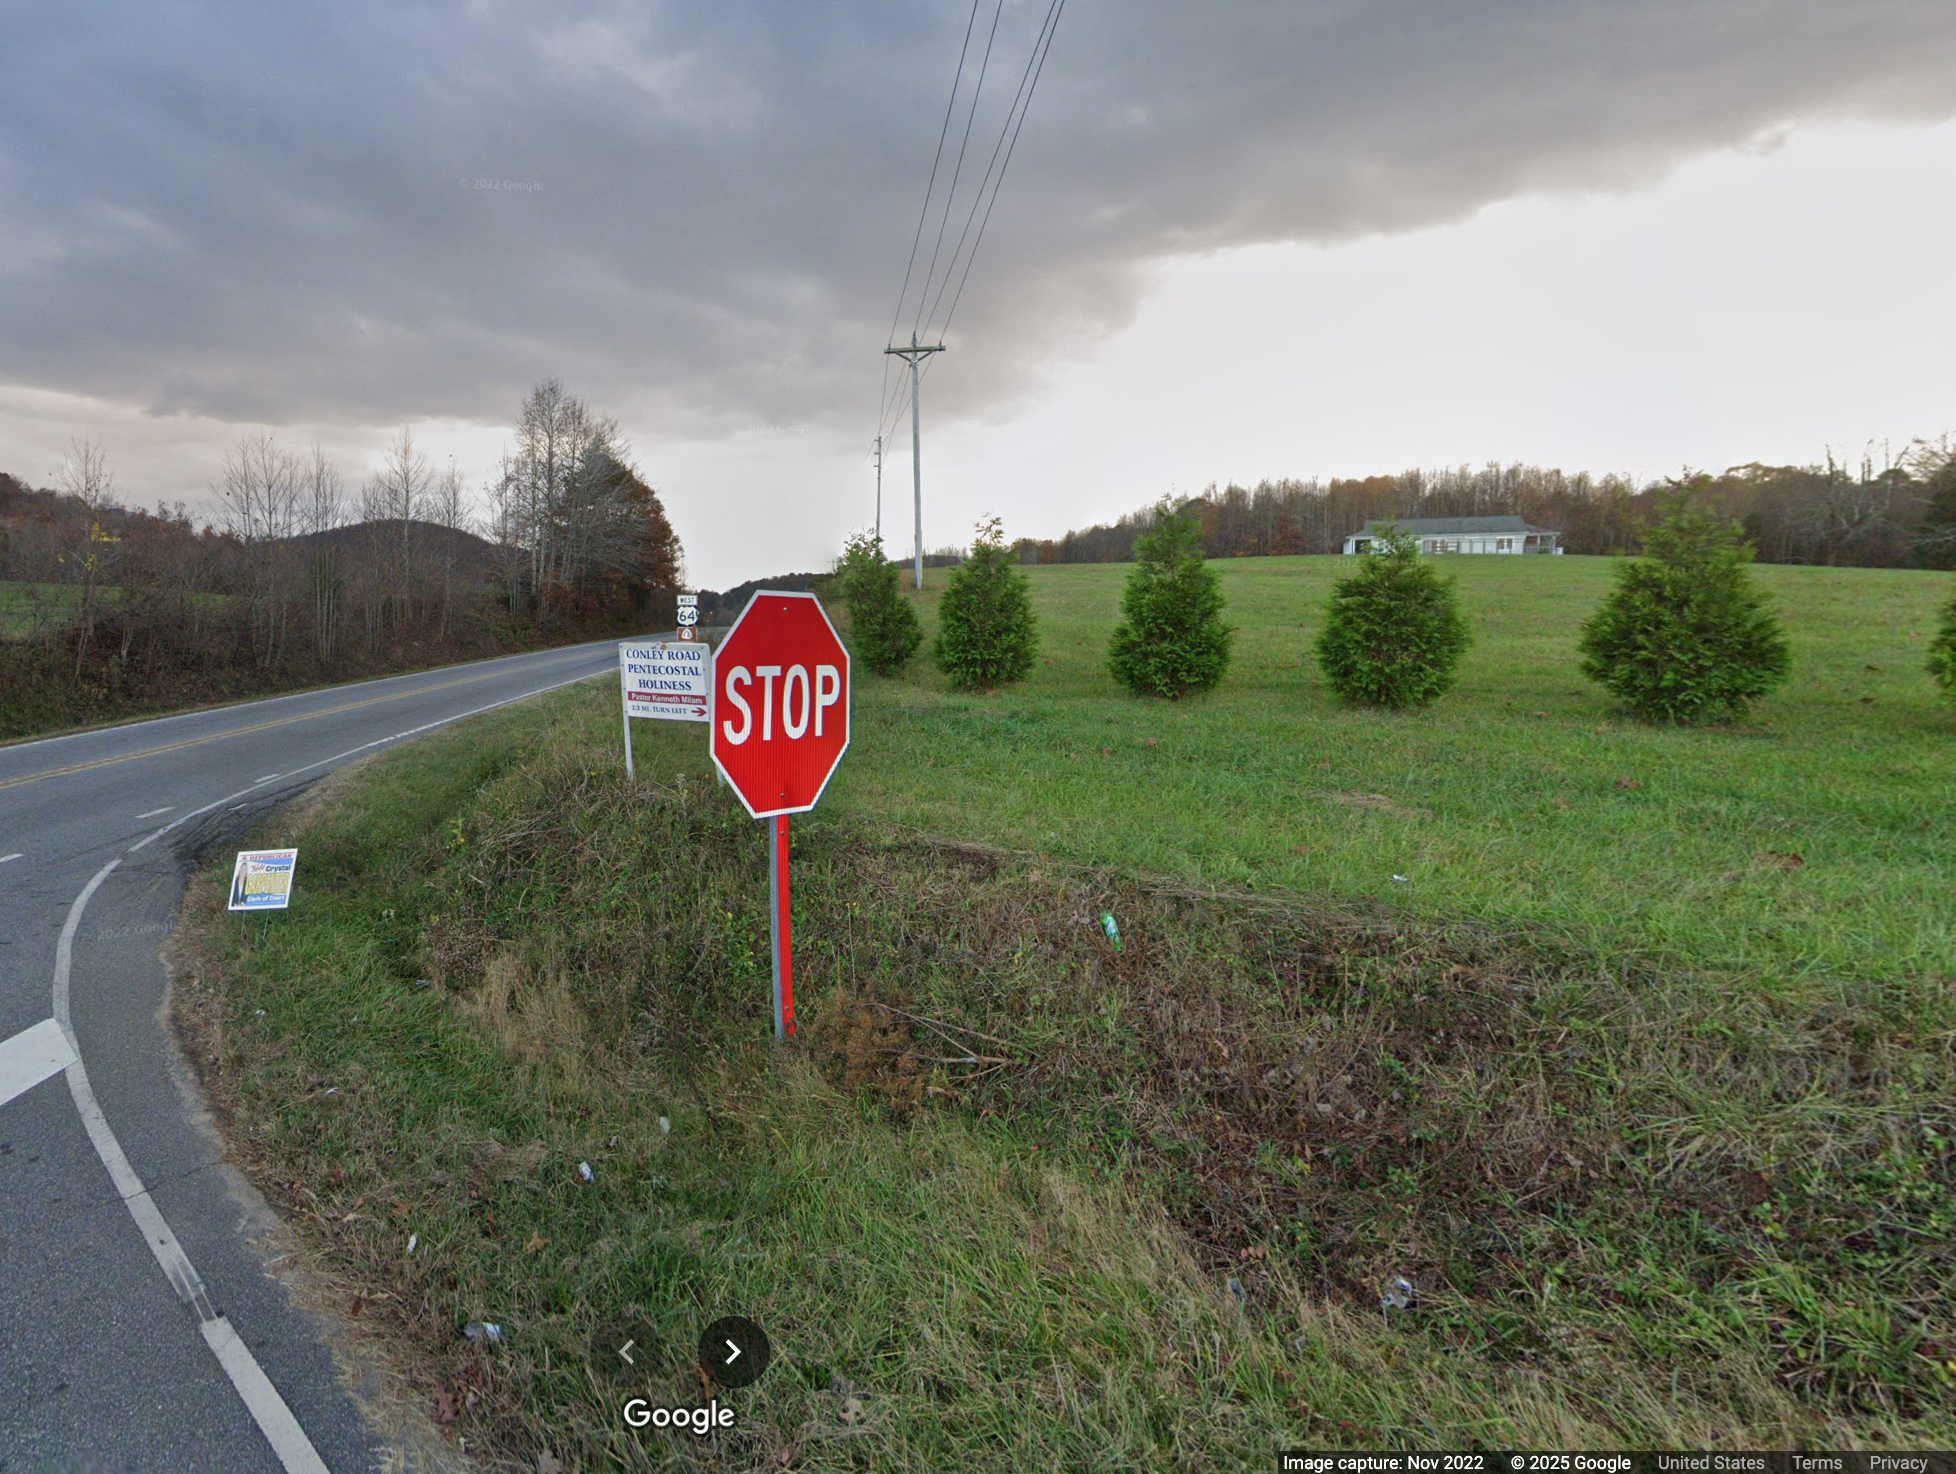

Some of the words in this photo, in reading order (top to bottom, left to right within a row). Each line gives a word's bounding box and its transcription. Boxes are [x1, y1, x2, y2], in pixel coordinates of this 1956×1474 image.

[679, 610, 695, 622] 64
[626, 649, 664, 660] CONLEY
[667, 650, 701, 661] ROAD
[627, 663, 702, 676] PENTECOSTAL
[638, 679, 692, 691] HOLINESS
[631, 692, 651, 701] Pastor
[652, 694, 680, 703] Kenneth
[681, 695, 703, 704] Milam
[723, 664, 840, 745] STOP
[245, 872, 290, 895] CARPENTER
